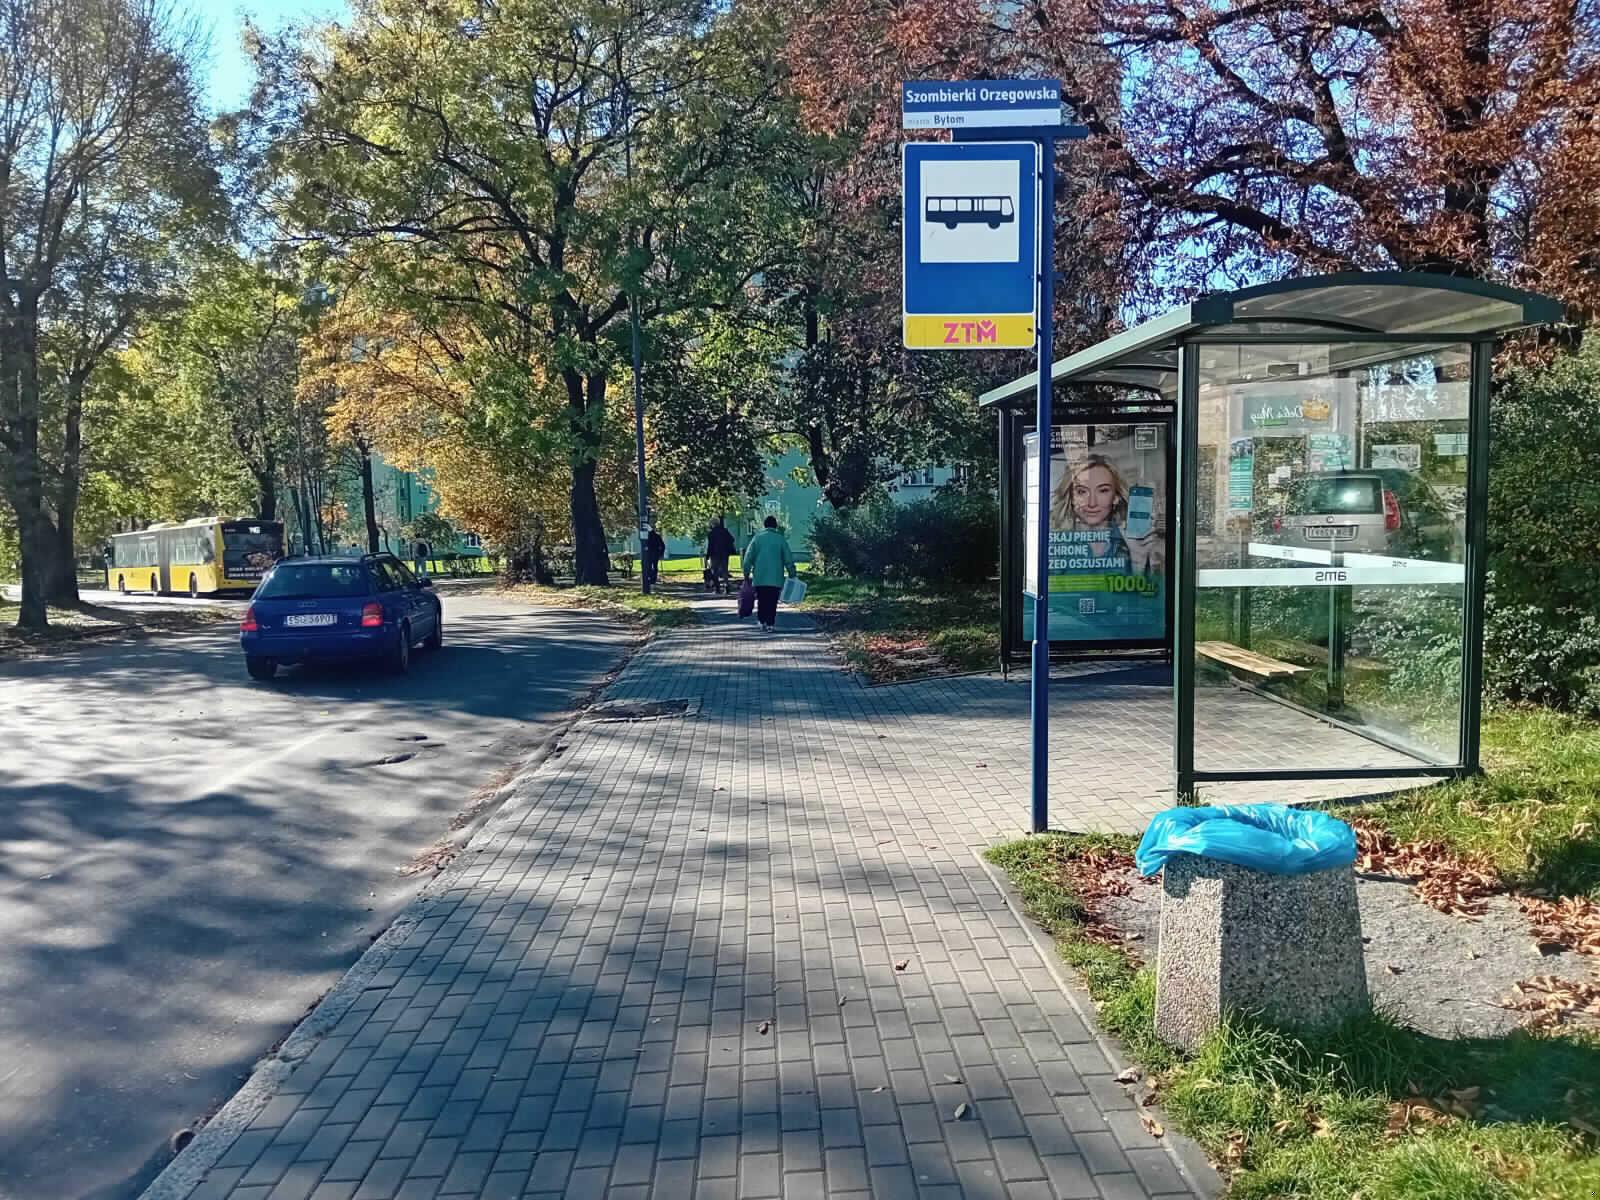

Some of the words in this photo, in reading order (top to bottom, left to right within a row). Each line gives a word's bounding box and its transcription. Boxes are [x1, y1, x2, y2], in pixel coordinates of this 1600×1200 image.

[906, 88, 976, 104] Szombierki
[980, 85, 1058, 104] Orzegowska
[934, 114, 965, 126] Bytom
[943, 320, 997, 344] ZTM
[1049, 531, 1072, 543] SKAJ
[1073, 530, 1111, 544] PREMIĘ
[1049, 544, 1088, 557] CHRONĘ
[1049, 559, 1067, 569] ZED
[1069, 558, 1125, 569] OSZUSTAMI
[1108, 576, 1145, 593] 1000
